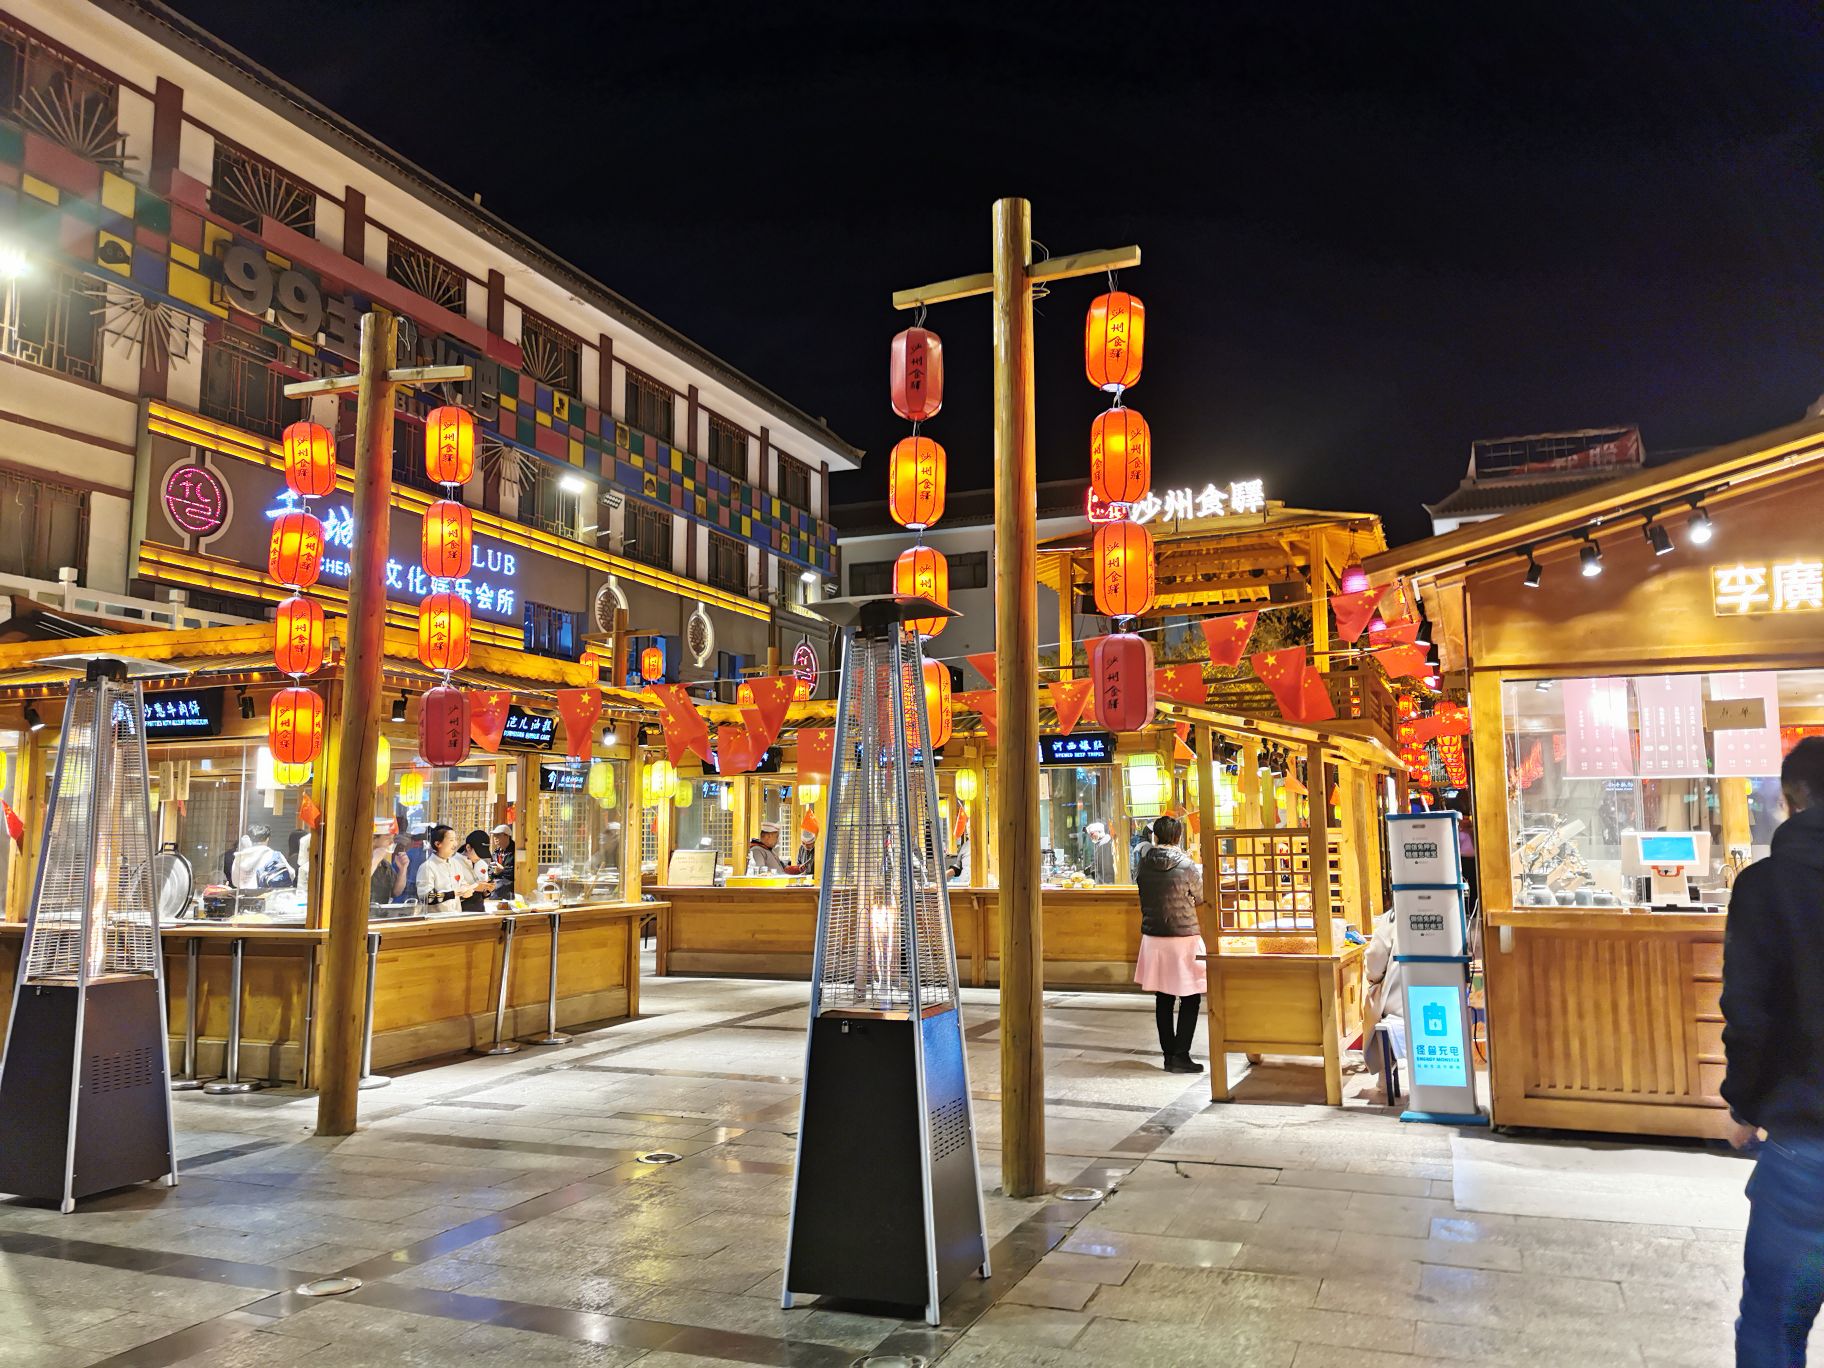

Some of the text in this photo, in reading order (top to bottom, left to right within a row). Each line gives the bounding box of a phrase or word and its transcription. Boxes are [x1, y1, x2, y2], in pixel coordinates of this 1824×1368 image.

[1131, 478, 1265, 524] 沙州食驛
[385, 560, 515, 616] 文化娱乐会所
[1106, 541, 1122, 598] 沙州食驛
[1714, 561, 1824, 613] 李廣
[1105, 655, 1121, 713] 沙州食驛
[1416, 1044, 1460, 1057] 怪兽充电
